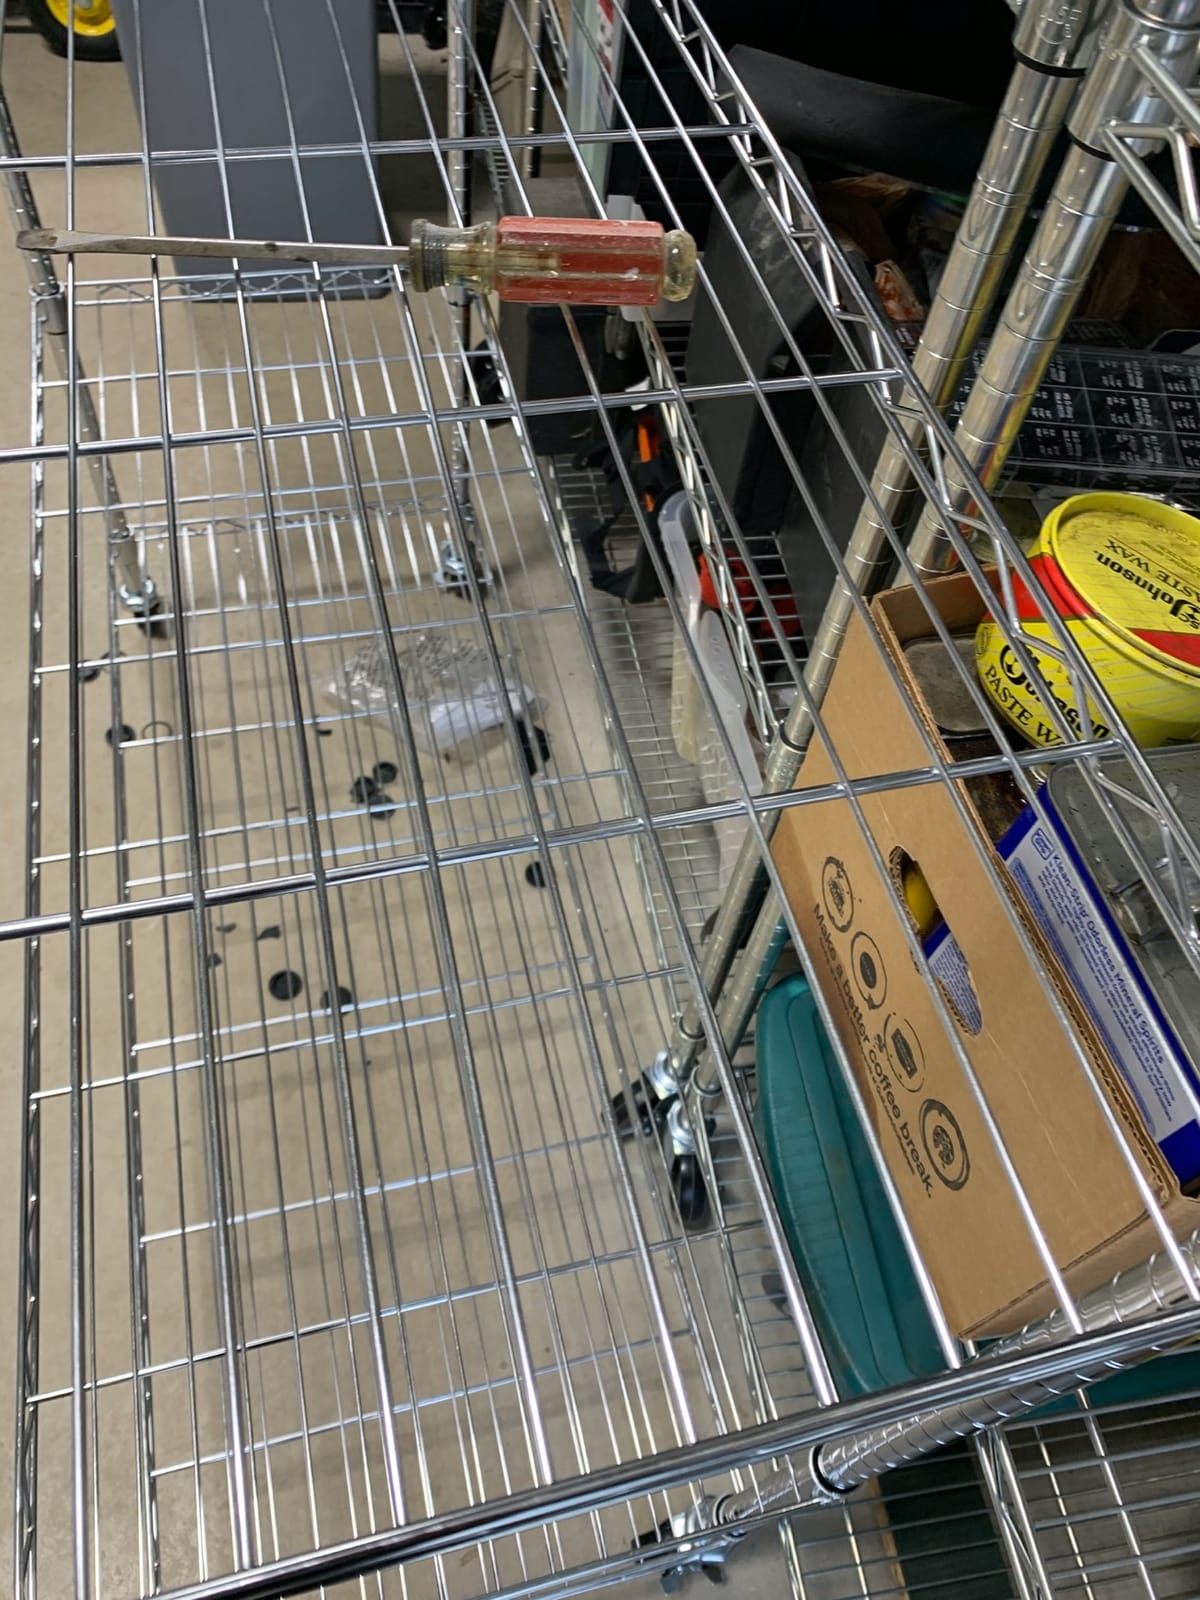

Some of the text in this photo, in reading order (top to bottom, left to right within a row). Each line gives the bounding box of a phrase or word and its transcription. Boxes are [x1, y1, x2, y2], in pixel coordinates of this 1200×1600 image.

[1095, 552, 1200, 617] Johnson
[1103, 538, 1151, 574] WAX
[985, 664, 1034, 726] PASTE
[1087, 919, 1116, 974] Odorless
[1113, 971, 1142, 1022] Mineral
[1138, 1017, 1165, 1065] Spirits
[813, 902, 837, 962] Make
[835, 964, 844, 979] a
[842, 978, 870, 1044] better
[869, 1049, 901, 1119] coffee
[899, 1121, 934, 1199] break.
